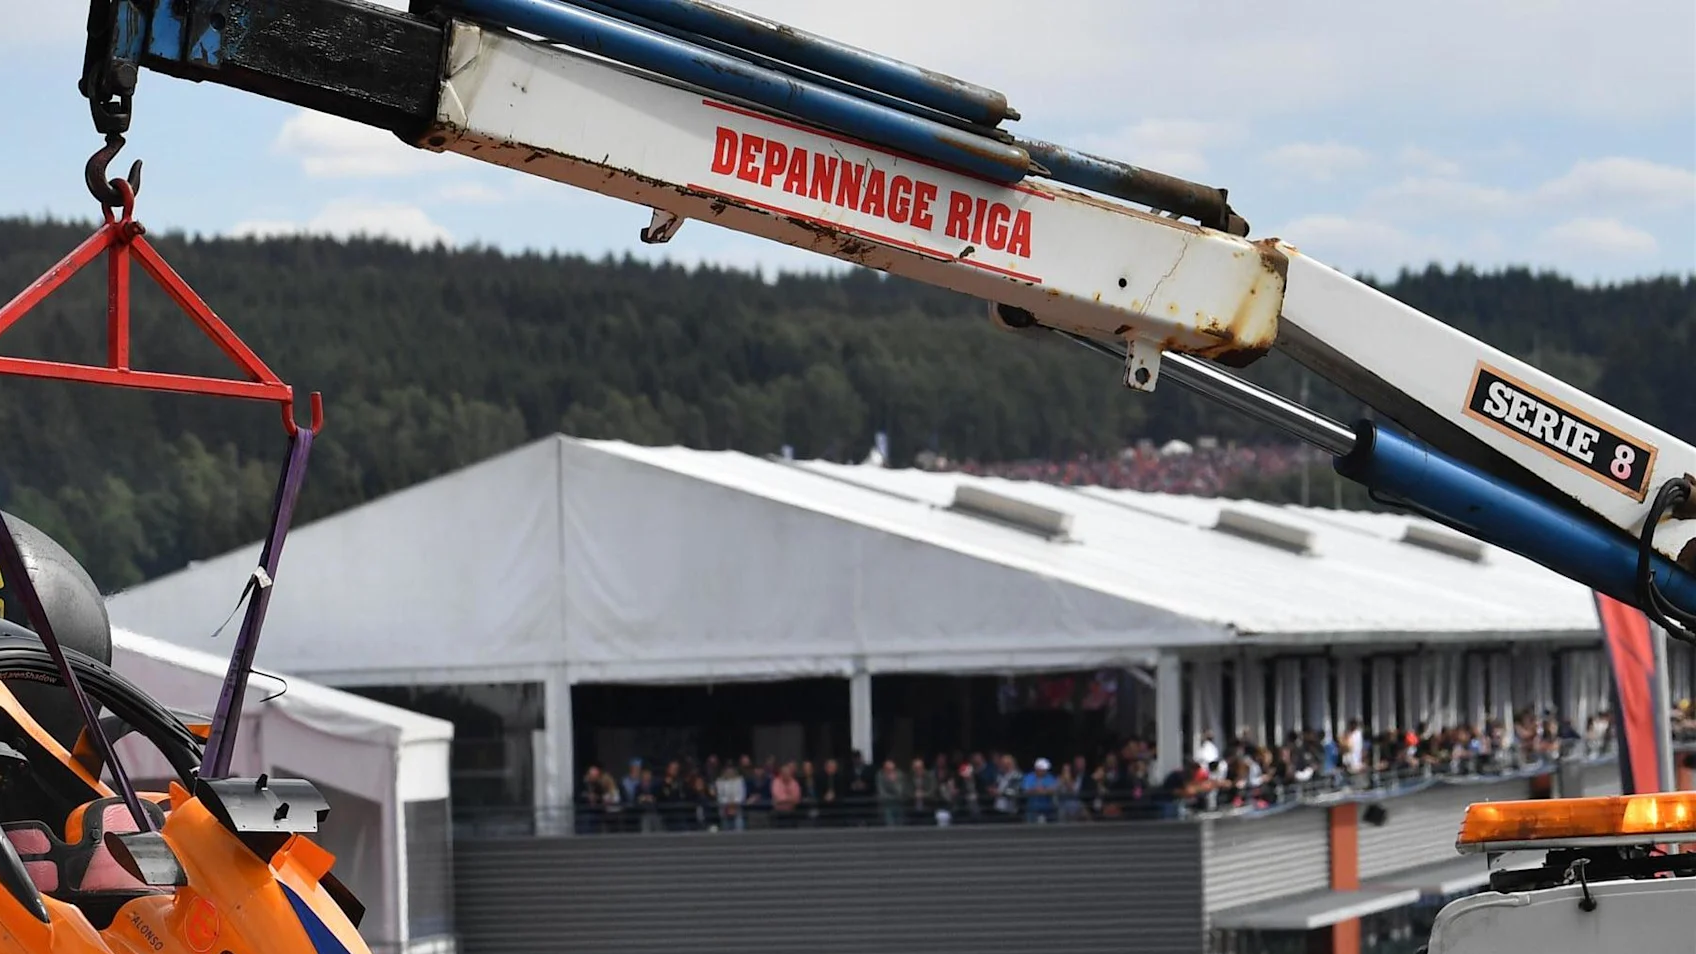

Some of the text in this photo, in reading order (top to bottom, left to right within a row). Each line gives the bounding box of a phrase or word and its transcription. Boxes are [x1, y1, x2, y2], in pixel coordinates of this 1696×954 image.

[711, 127, 1032, 258] DEPANNAGE RIGA
[1483, 381, 1636, 480] SERIE 8
